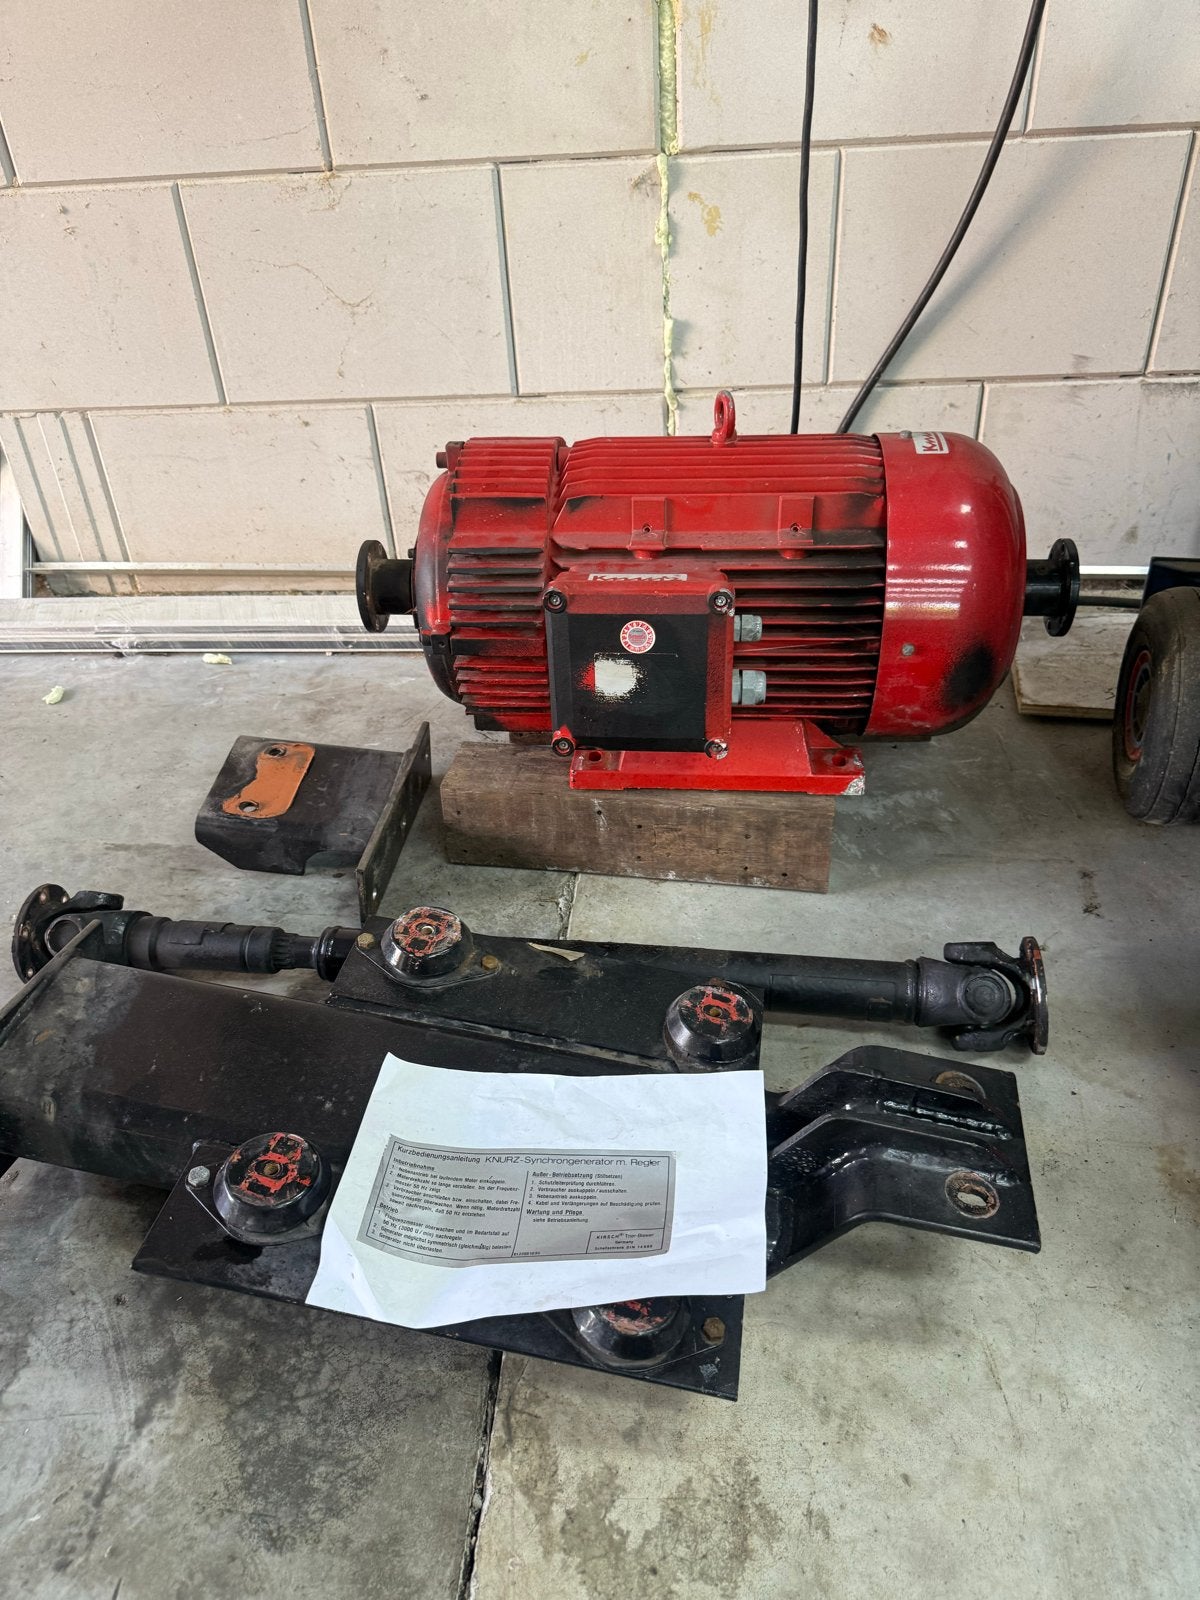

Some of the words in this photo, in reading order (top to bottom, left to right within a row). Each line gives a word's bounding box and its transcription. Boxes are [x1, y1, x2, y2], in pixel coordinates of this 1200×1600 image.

[398, 1146, 480, 1164] Kurzbedienungsanleitung
[485, 1156, 614, 1166] KNURZ-Synchrongenerator
[630, 1158, 661, 1167] Regler
[380, 1202, 398, 1214] Betrieb
